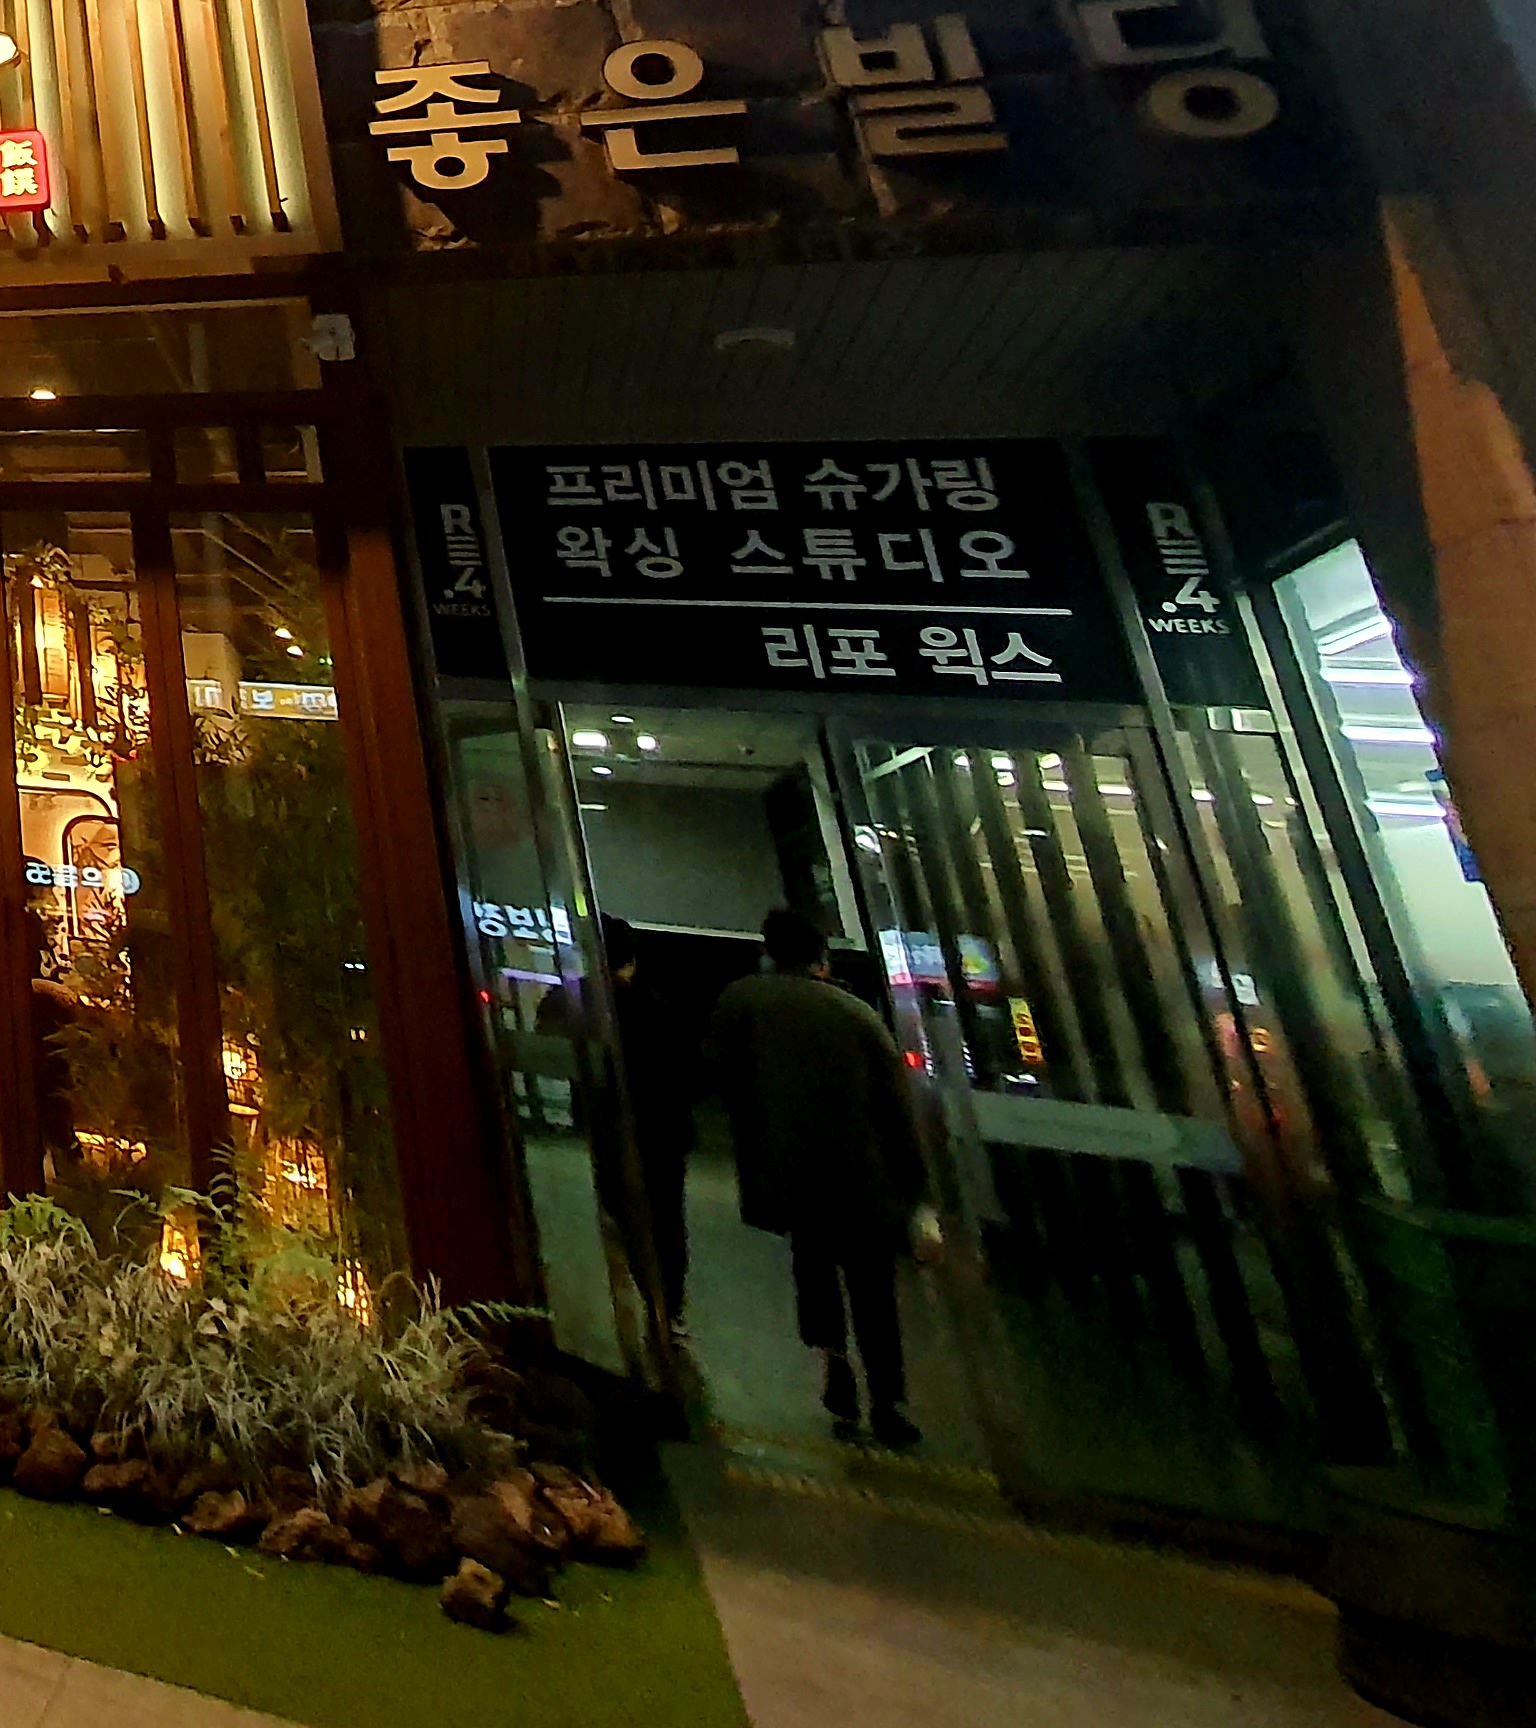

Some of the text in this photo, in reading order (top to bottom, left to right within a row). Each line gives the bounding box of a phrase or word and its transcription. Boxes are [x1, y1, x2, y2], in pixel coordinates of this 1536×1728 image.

[542, 455, 1004, 515] 프리미엄 슈가링
[554, 521, 1033, 584] 왁싱 스튜디오
[432, 603, 492, 618] WEEKS
[1147, 615, 1234, 639] WEEKS
[761, 623, 1066, 687] 리포 웍스
